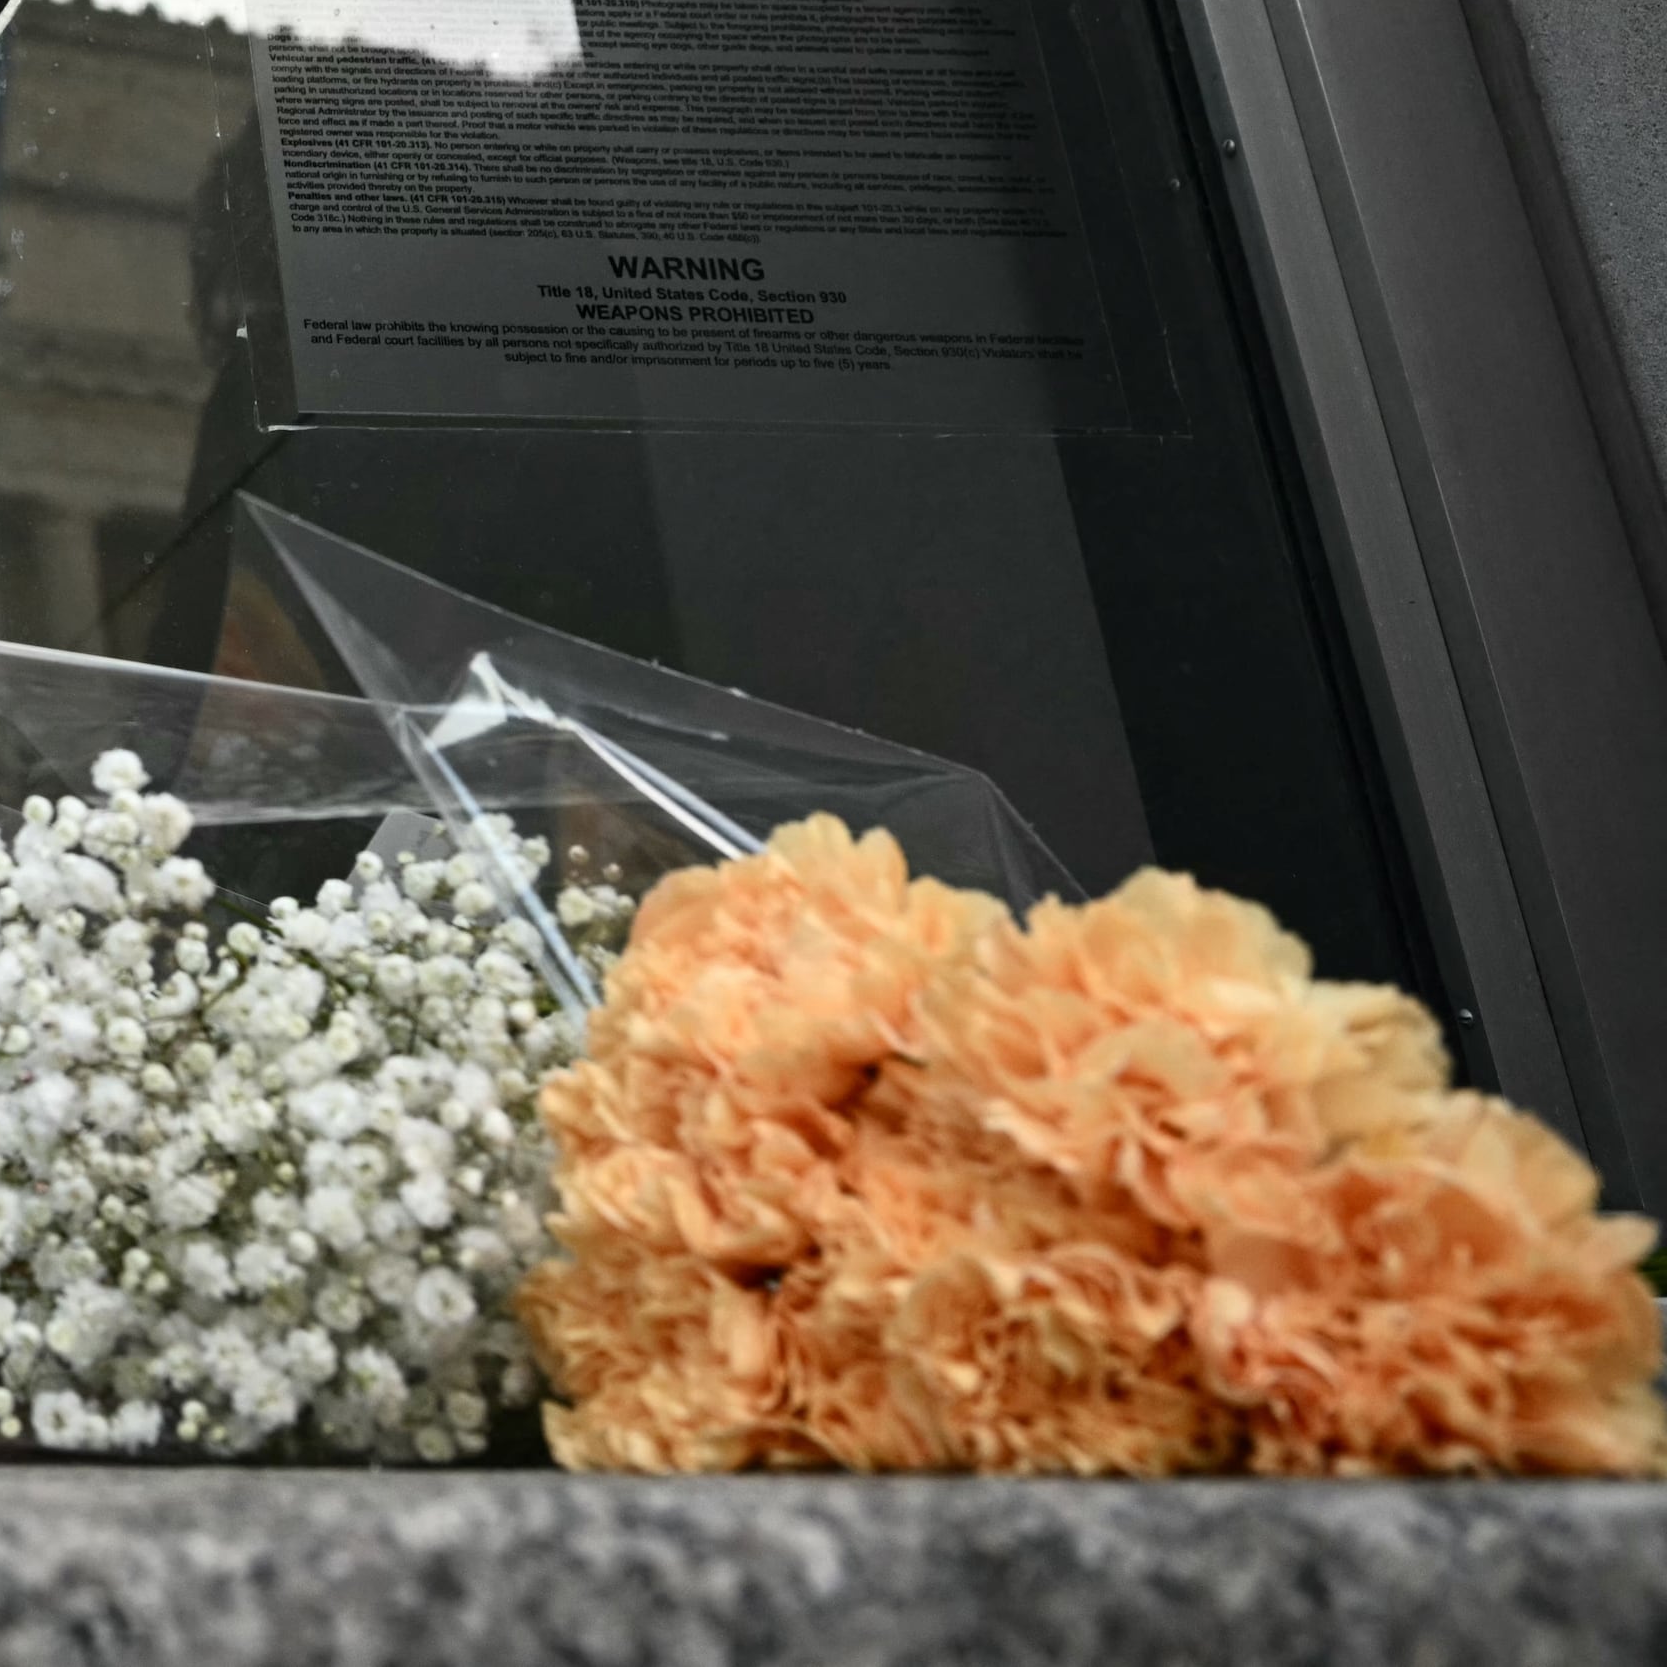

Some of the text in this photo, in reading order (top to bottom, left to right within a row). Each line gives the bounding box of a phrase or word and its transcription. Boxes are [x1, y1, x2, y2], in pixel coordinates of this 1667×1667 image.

[608, 255, 765, 281] WARNING
[537, 285, 848, 305] Title 18, United States Code, Section 930
[576, 305, 815, 325] WEAPONS PROHIBITED
[303, 319, 349, 331] Federal
[351, 320, 372, 331] law
[374, 320, 425, 335] prohibits
[427, 321, 447, 333] the
[449, 322, 499, 336] knowing
[501, 323, 569, 338] possession
[571, 326, 583, 335] or
[586, 324, 605, 336] the
[608, 325, 655, 339] causing
[657, 327, 669, 337] to
[671, 326, 687, 337] be
[690, 327, 735, 341] present
[737, 327, 750, 339] of
[752, 328, 801, 340] firearms
[803, 331, 816, 340] or
[819, 329, 850, 341] other
[852, 330, 916, 345] dangerous
[975, 332, 987, 343] in
[988, 332, 1035, 345] Federal
[310, 334, 333, 345] and
[335, 334, 381, 346] Federal
[383, 336, 414, 347] court
[416, 336, 465, 347] facilities
[467, 336, 482, 350] by
[484, 337, 499, 348] all
[501, 339, 550, 352] persons
[552, 339, 572, 350] not
[574, 339, 639, 354] specifically
[642, 340, 705, 352] authorized
[707, 341, 723, 355] by
[725, 342, 751, 353] Title
[753, 343, 769, 354] 18
[771, 343, 811, 355] United
[813, 344, 852, 356] States
[854, 345, 891, 358] Code,
[893, 345, 939, 357] Section
[504, 352, 547, 366] subject
[549, 354, 562, 364] to
[565, 353, 587, 365] fine
[589, 354, 628, 365] and/or
[630, 354, 711, 369] imprisonment
[713, 356, 730, 367] for
[733, 356, 777, 371] periods
[779, 360, 796, 371] up
[798, 359, 811, 369] to
[813, 358, 835, 369] five
[837, 358, 855, 372] (5)
